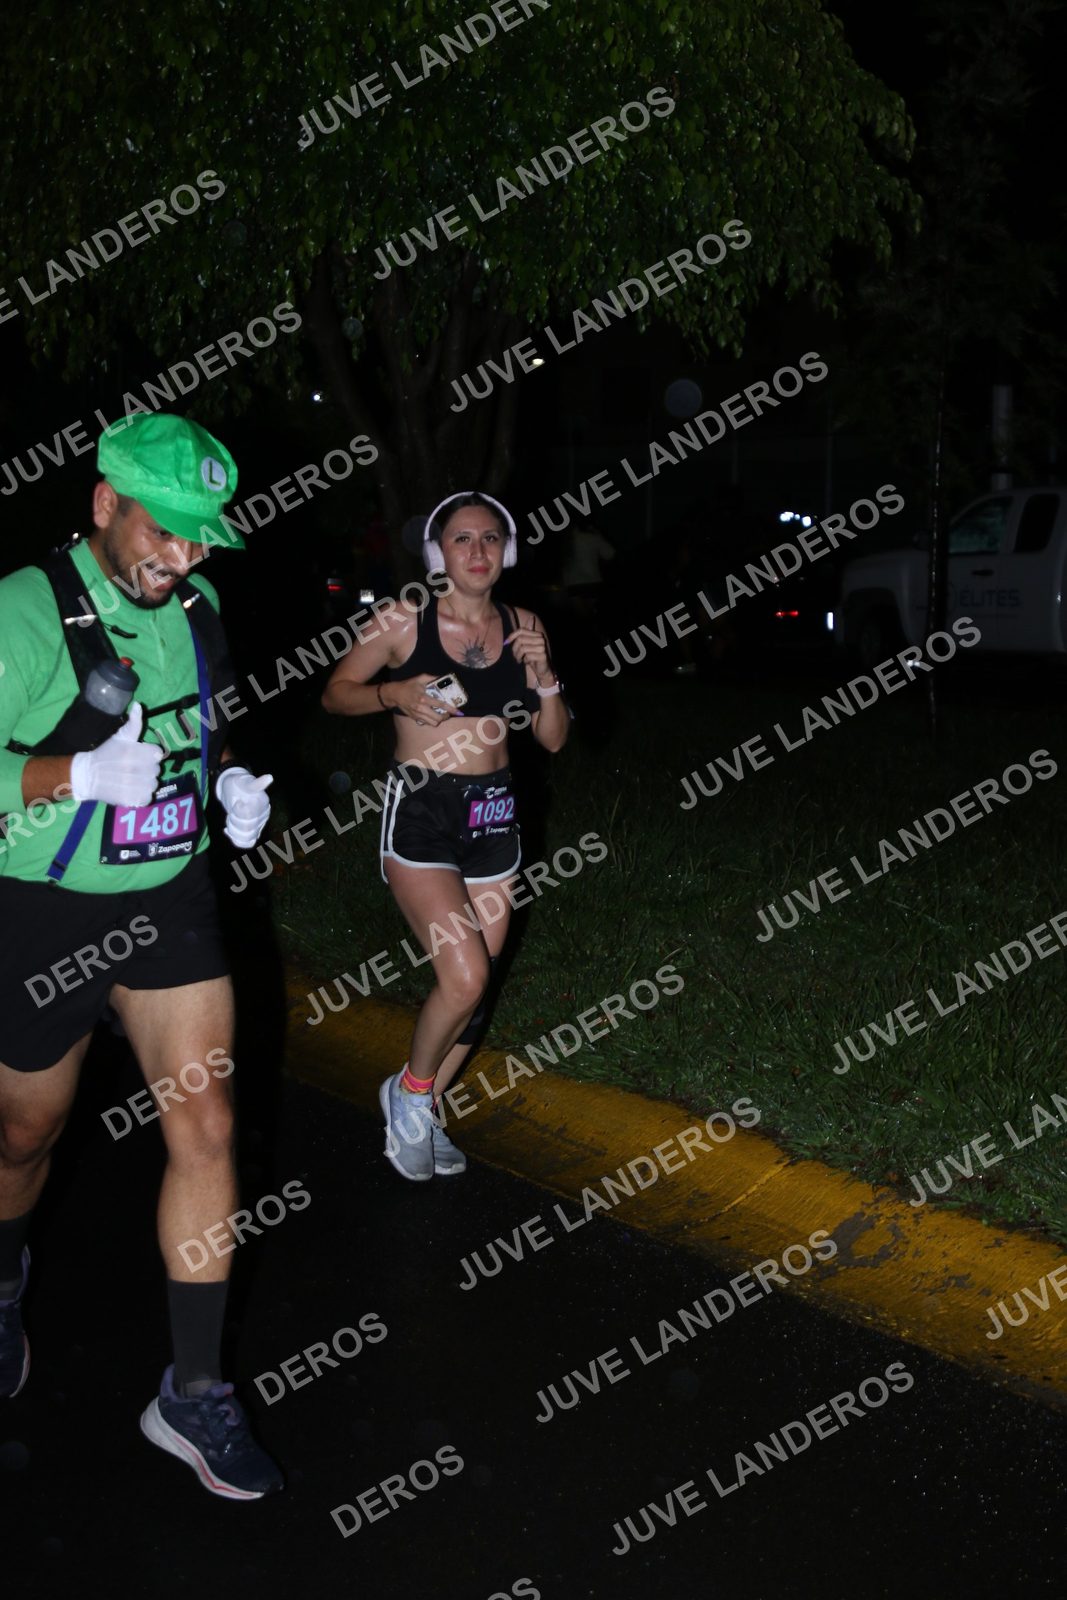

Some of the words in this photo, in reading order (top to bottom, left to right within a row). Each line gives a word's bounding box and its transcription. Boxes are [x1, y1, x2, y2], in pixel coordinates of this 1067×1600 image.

[209, 460, 221, 486] L
[120, 797, 193, 841] 1487
[474, 797, 514, 825] 1092
